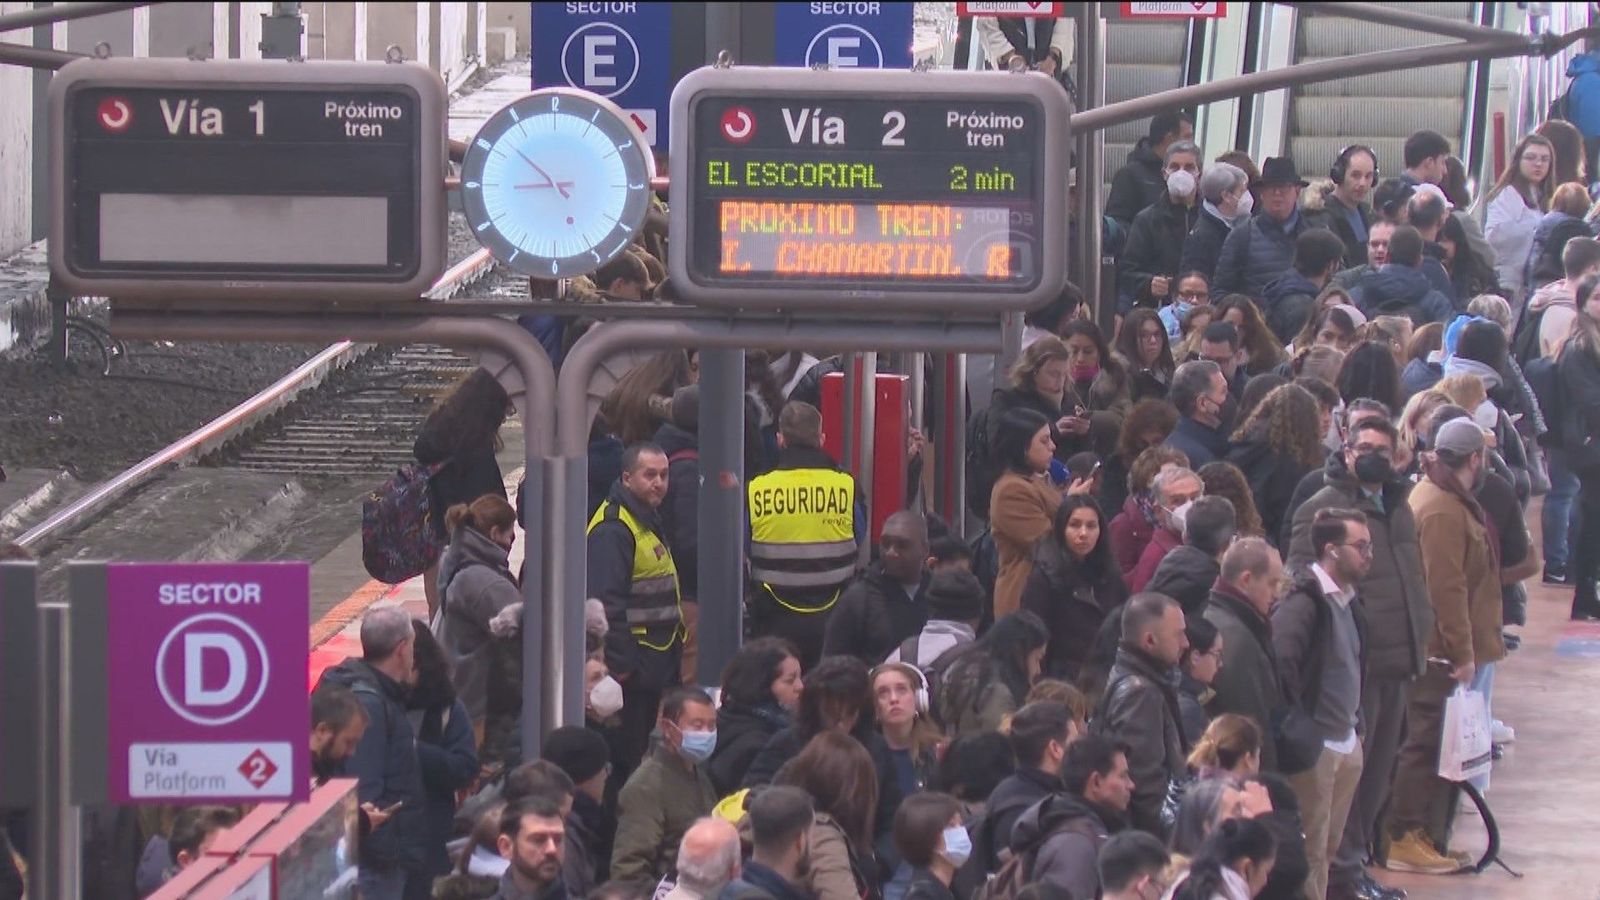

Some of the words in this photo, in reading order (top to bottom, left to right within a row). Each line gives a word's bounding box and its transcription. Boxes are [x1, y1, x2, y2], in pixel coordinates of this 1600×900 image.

[566, 2, 637, 14] SECTOR
[810, 2, 881, 15] SECTOR
[584, 35, 617, 87] E
[324, 100, 403, 120] Próximo
[551, 96, 560, 112] 12
[159, 98, 225, 136] Vía
[248, 99, 266, 136] 1
[782, 107, 846, 146] Vía
[881, 111, 907, 147] 2
[946, 110, 1025, 130] Próximo
[345, 121, 384, 138] tren
[966, 130, 1005, 147] tren
[618, 139, 633, 151] 2
[707, 160, 739, 187] EL
[745, 162, 884, 191] ESCORIAL
[949, 165, 969, 191] 2
[974, 166, 1016, 192] min
[720, 200, 856, 235] PROXIMO
[876, 203, 963, 239] TREN:
[551, 259, 559, 275] 6
[753, 486, 849, 517] SEGURIDAD
[158, 583, 261, 605] SECTOR
[184, 632, 248, 706] D
[250, 757, 266, 781] 2
[144, 771, 226, 795] Platform
